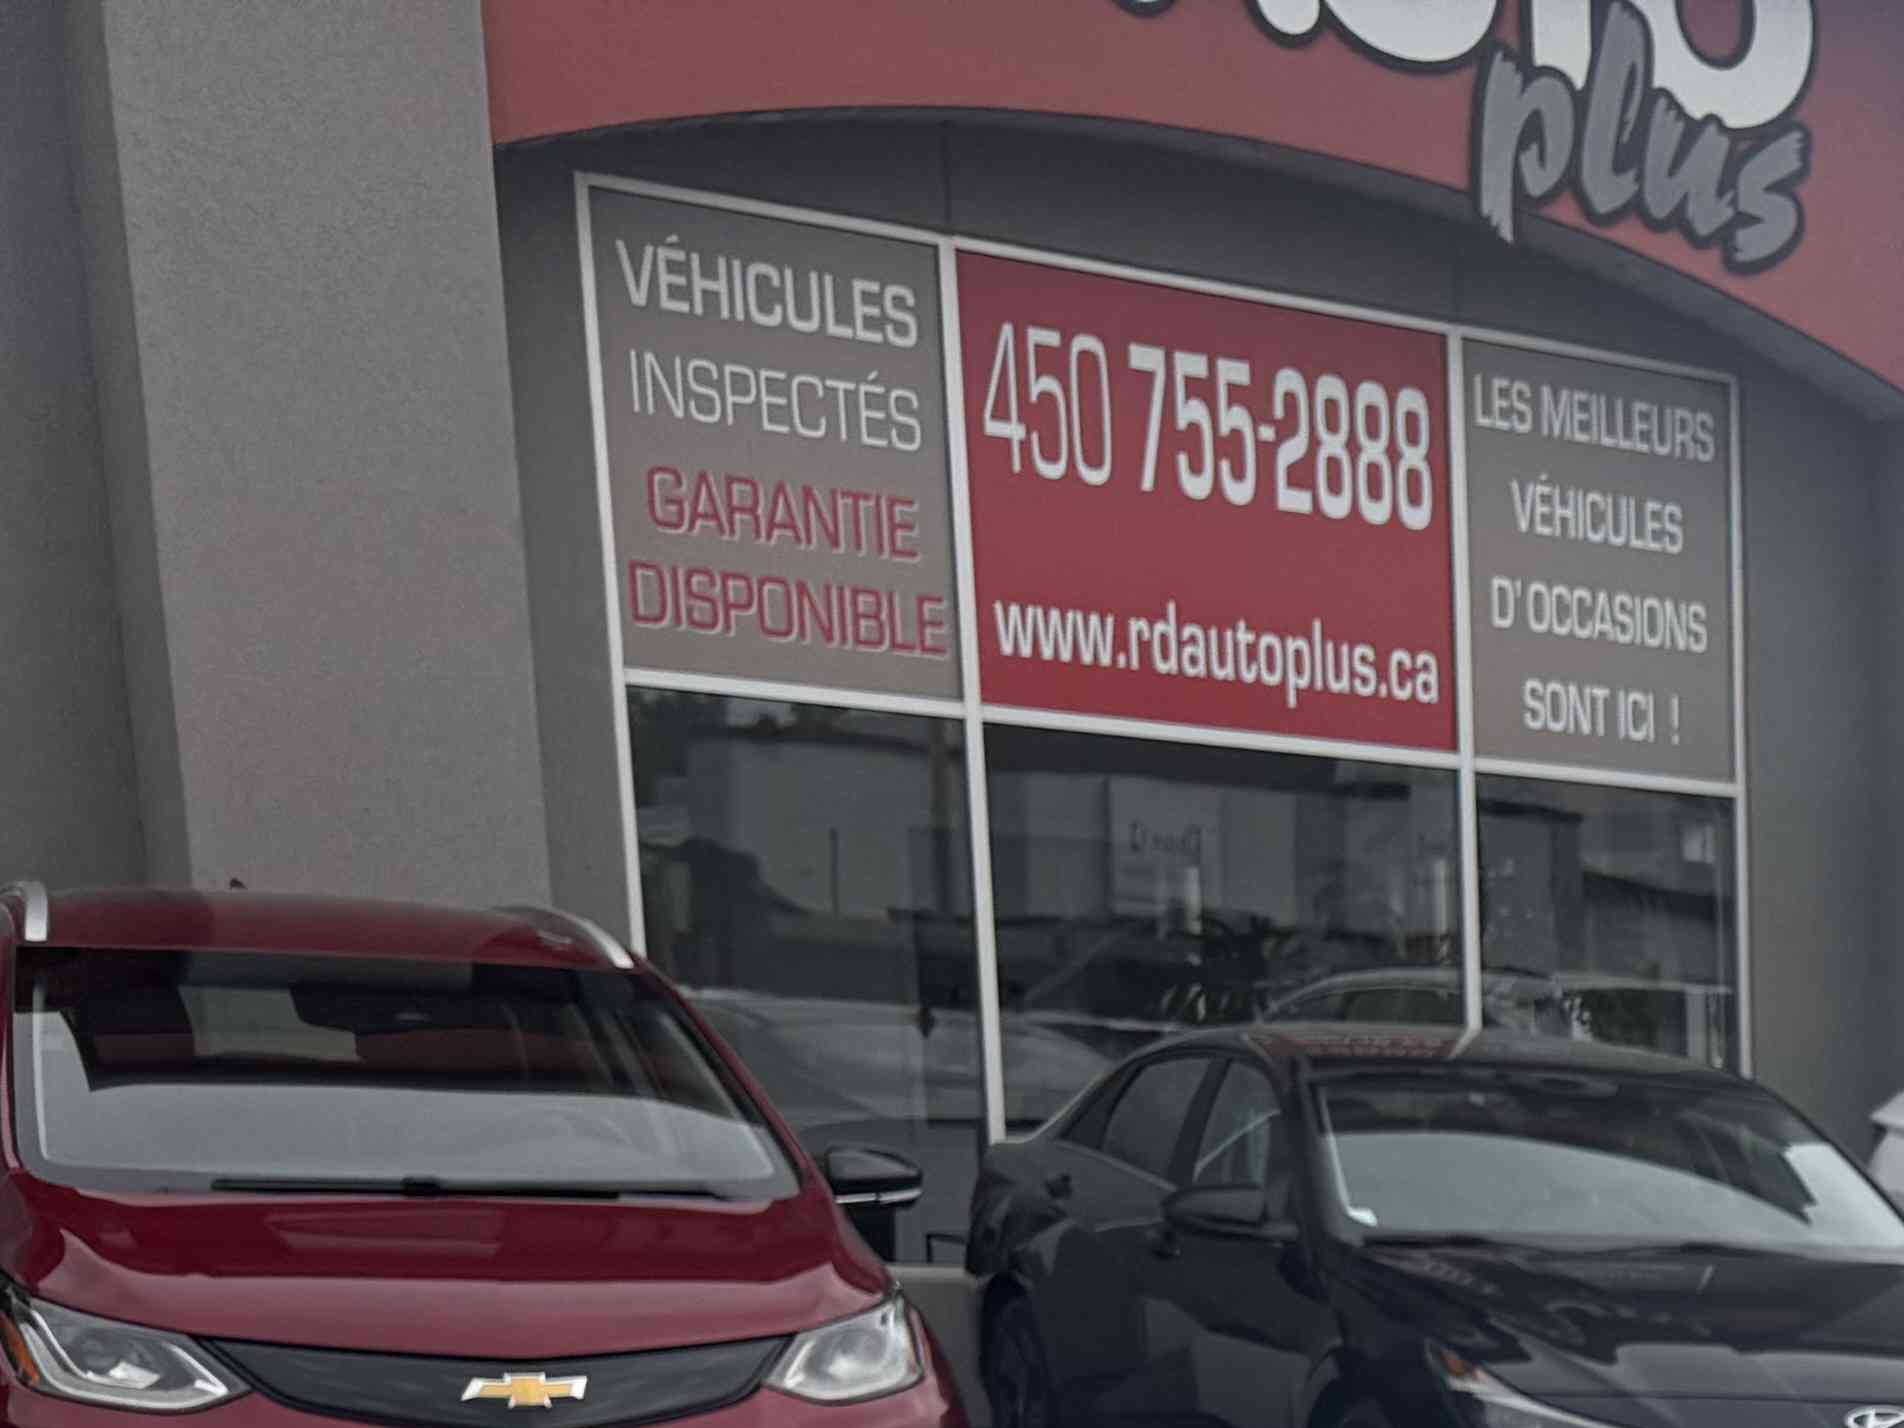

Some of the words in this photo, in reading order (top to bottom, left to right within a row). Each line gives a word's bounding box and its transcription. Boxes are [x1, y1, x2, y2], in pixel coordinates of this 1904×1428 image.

[1480, 5, 1811, 264] plus
[615, 233, 918, 348] VÉHICULES
[629, 348, 922, 452] INSPECTÉS
[983, 321, 1112, 486] 450
[1128, 342, 1433, 531] 755-2888
[1473, 373, 1533, 434] LES
[1540, 384, 1715, 463] MEILLEURS
[646, 464, 922, 564] GARANTIE
[1509, 472, 1684, 555] VÉHICULES
[627, 558, 950, 660] DISPONIBLE
[993, 598, 1440, 708] www.rdautoplus.ca
[1523, 677, 1609, 737] SONT
[1617, 690, 1656, 743] ICI
